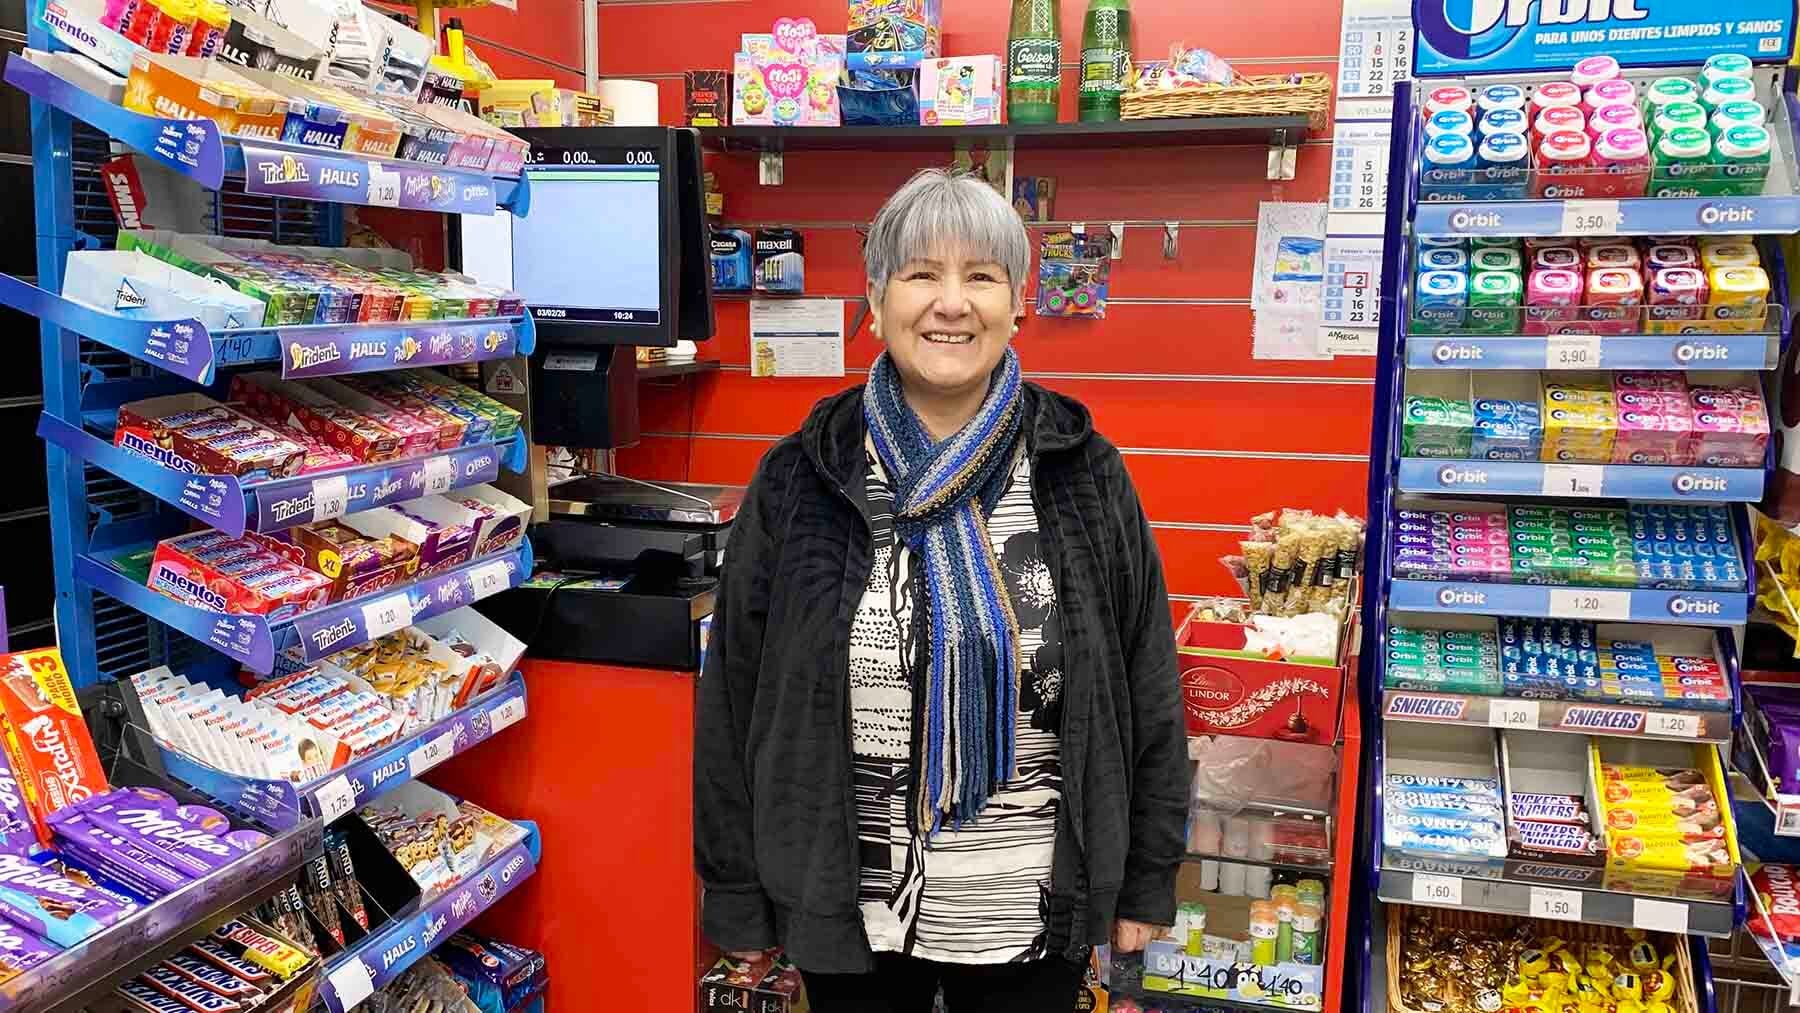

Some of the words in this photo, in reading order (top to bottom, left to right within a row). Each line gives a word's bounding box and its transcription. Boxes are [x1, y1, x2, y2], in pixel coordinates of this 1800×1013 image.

[44, 10, 99, 48] mentos
[1535, 32, 1567, 45] PARA
[1571, 29, 1609, 43] UNOS
[1609, 26, 1662, 41] DIENTES
[1664, 23, 1721, 38] LIMPIOS
[1725, 22, 1735, 35] Y
[1737, 20, 1783, 34] SANOS
[1376, 32, 1382, 42] 1
[1399, 31, 1406, 41] 2
[1018, 47, 1056, 64] Geiser
[1374, 45, 1382, 55] 8
[1398, 45, 1405, 54] 9
[1371, 58, 1383, 68] 15
[1394, 57, 1407, 67] 16
[276, 62, 312, 81] HALLS
[1369, 71, 1384, 81] 22
[1392, 70, 1407, 80] 23
[1368, 84, 1383, 94] 29
[433, 96, 458, 109] HALLS
[237, 124, 280, 138] HALLS
[303, 130, 341, 146] HALLS
[362, 140, 395, 155] HALLS
[416, 152, 447, 164] HALLS
[1365, 161, 1372, 170] 5
[1487, 166, 1520, 178] Orbit
[320, 168, 360, 186] HALLS
[1362, 173, 1374, 183] 12
[1360, 185, 1373, 195] 19
[1545, 186, 1584, 198] Orbit
[1360, 198, 1373, 207] 26
[1453, 209, 1501, 228] Orbit
[1702, 206, 1753, 223] Orbit
[1575, 216, 1603, 230] 3,50
[756, 239, 792, 250] maxell
[1356, 275, 1363, 285] 2
[116, 288, 146, 306] Trident
[1355, 288, 1362, 298] 9
[1352, 300, 1364, 309] 16
[614, 312, 633, 320] 10:24
[1350, 312, 1364, 322] 23
[1422, 310, 1454, 320] Orbit
[1472, 310, 1504, 319] Orbit
[144, 348, 165, 360] HALLS
[350, 342, 387, 360] HALLS
[1436, 344, 1483, 360] Orbit
[1560, 351, 1587, 364] 3,90
[1677, 344, 1728, 360] Orbit
[1480, 402, 1511, 412] Orbit
[1481, 421, 1512, 430] Orbit
[124, 431, 196, 474] mentos
[1489, 451, 1519, 459] Orbit
[1441, 468, 1488, 483] Orbit
[1677, 474, 1727, 491] Orbit
[271, 494, 315, 522] Trident
[465, 456, 492, 477] OREO
[180, 497, 198, 510] HALLS
[323, 499, 340, 516] 1.30
[1517, 533, 1545, 541] Orbit
[323, 557, 336, 573] XL
[159, 565, 226, 610] mentos
[262, 577, 301, 592] mentos
[1440, 589, 1487, 604] Orbit
[1573, 598, 1599, 610] 1.20
[1671, 599, 1720, 614] Orbit
[379, 609, 395, 626] 1.20
[313, 617, 357, 650] Trident
[210, 636, 228, 648] HALLS
[1391, 640, 1417, 648] Orbit
[1391, 652, 1418, 660] Orbit
[29, 655, 57, 673] 3
[1619, 662, 1648, 670] Orbit
[1679, 664, 1709, 672] Orbit
[1565, 664, 1576, 684] Orbit
[1585, 666, 1596, 686] Orbit
[43, 674, 59, 700] PACK
[1682, 678, 1712, 686] Orbit
[53, 672, 77, 708] AHORRO
[1189, 689, 1230, 701] LINDOR
[1390, 697, 1464, 716] SNICKERS
[1503, 711, 1527, 724] 1,20
[1564, 708, 1642, 729] SNICKERS
[1660, 718, 1685, 731] 1.20
[424, 745, 439, 761] 1.20
[372, 756, 406, 788] HALLS
[1392, 776, 1460, 786] BOUNTY
[330, 794, 348, 814] 1.75
[116, 808, 231, 857] Milka
[339, 843, 354, 876] KIND
[315, 855, 330, 889] KIND
[1518, 865, 1590, 881] SNICKERS
[1426, 885, 1450, 898] 1.60
[383, 935, 417, 971] HALLS
[501, 854, 525, 883] OREO
[1544, 902, 1569, 914] 1.50
[239, 926, 281, 954] SUPER
